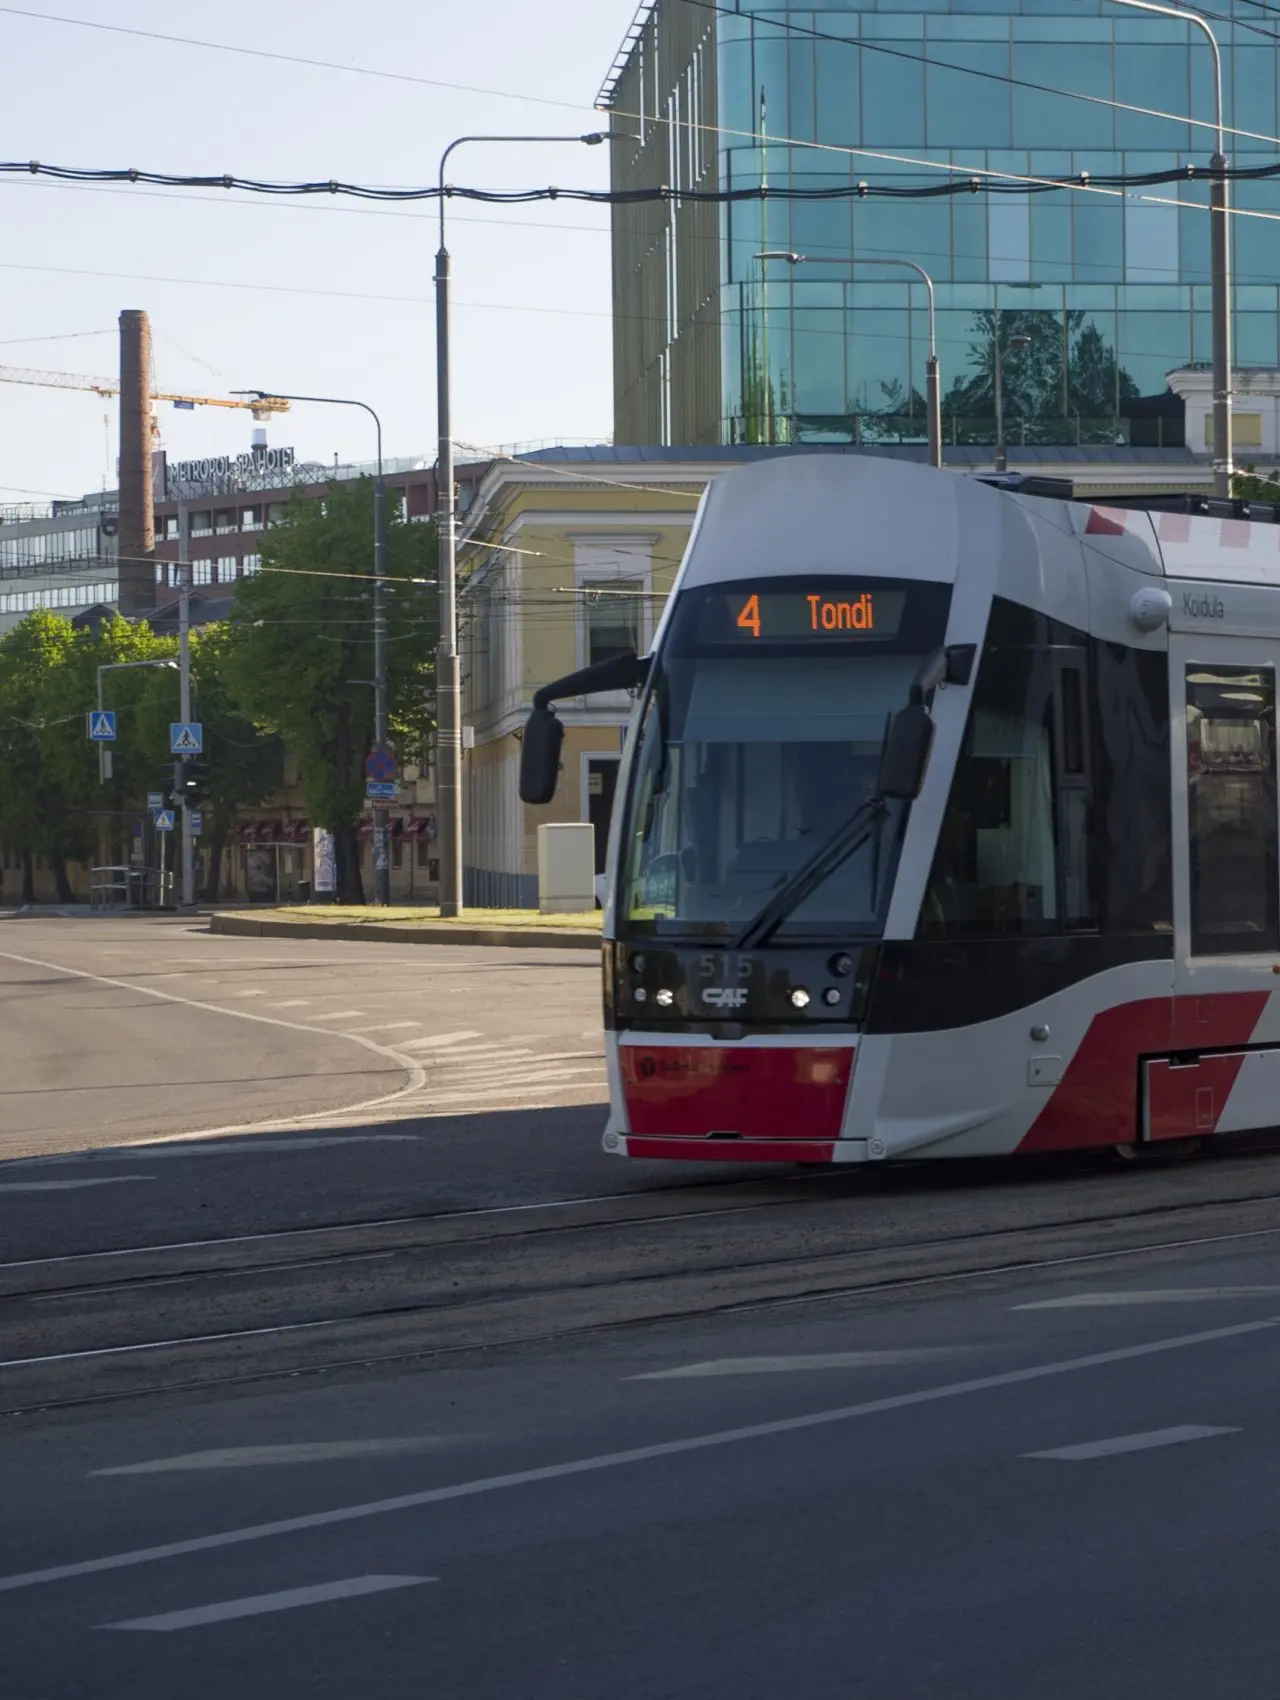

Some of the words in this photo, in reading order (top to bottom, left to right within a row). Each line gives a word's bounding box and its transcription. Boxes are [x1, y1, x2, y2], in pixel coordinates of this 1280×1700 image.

[170, 456, 231, 483] METROPOL
[235, 452, 254, 472] SPA
[256, 446, 295, 470] HOTEL
[736, 594, 761, 637] 4
[806, 593, 873, 630] Tondi
[1182, 592, 1224, 619] Koidula
[699, 953, 754, 978] 515
[702, 987, 749, 1008] CAF
